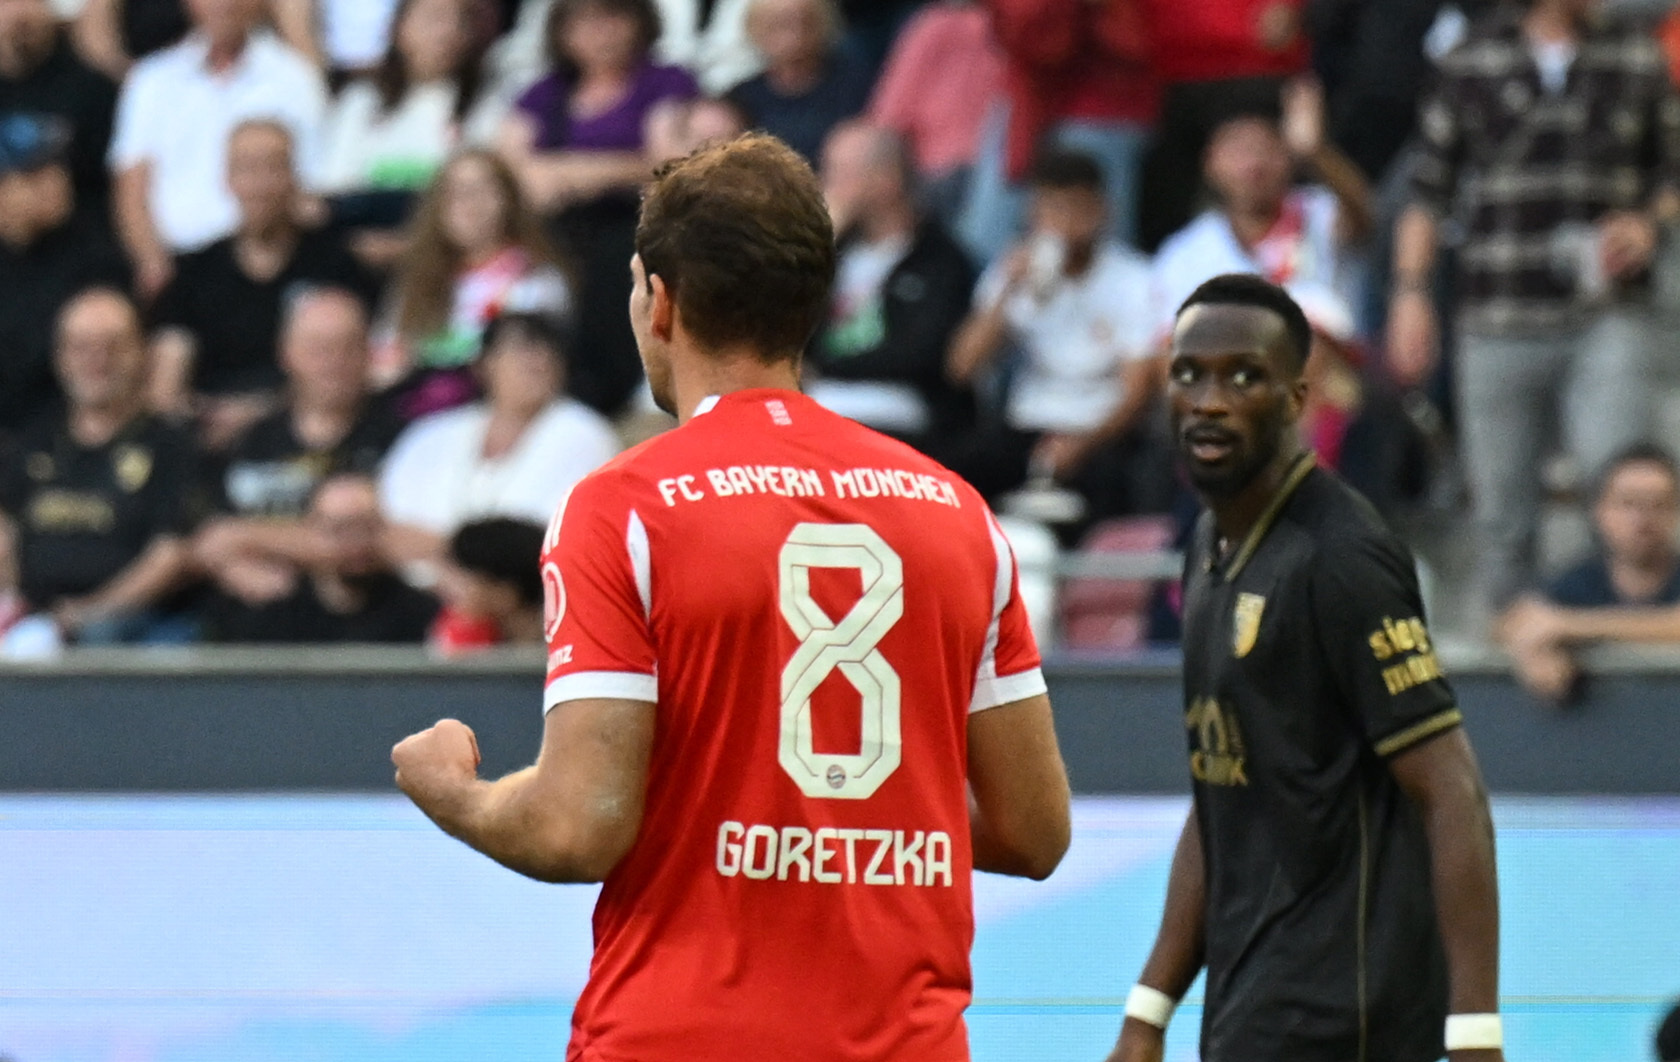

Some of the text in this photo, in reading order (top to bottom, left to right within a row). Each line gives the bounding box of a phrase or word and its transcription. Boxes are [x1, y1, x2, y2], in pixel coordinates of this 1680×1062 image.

[658, 474, 705, 507] FC
[706, 465, 825, 498] BAYERN
[778, 522, 904, 799] 8
[716, 820, 953, 887] GORETZKA
